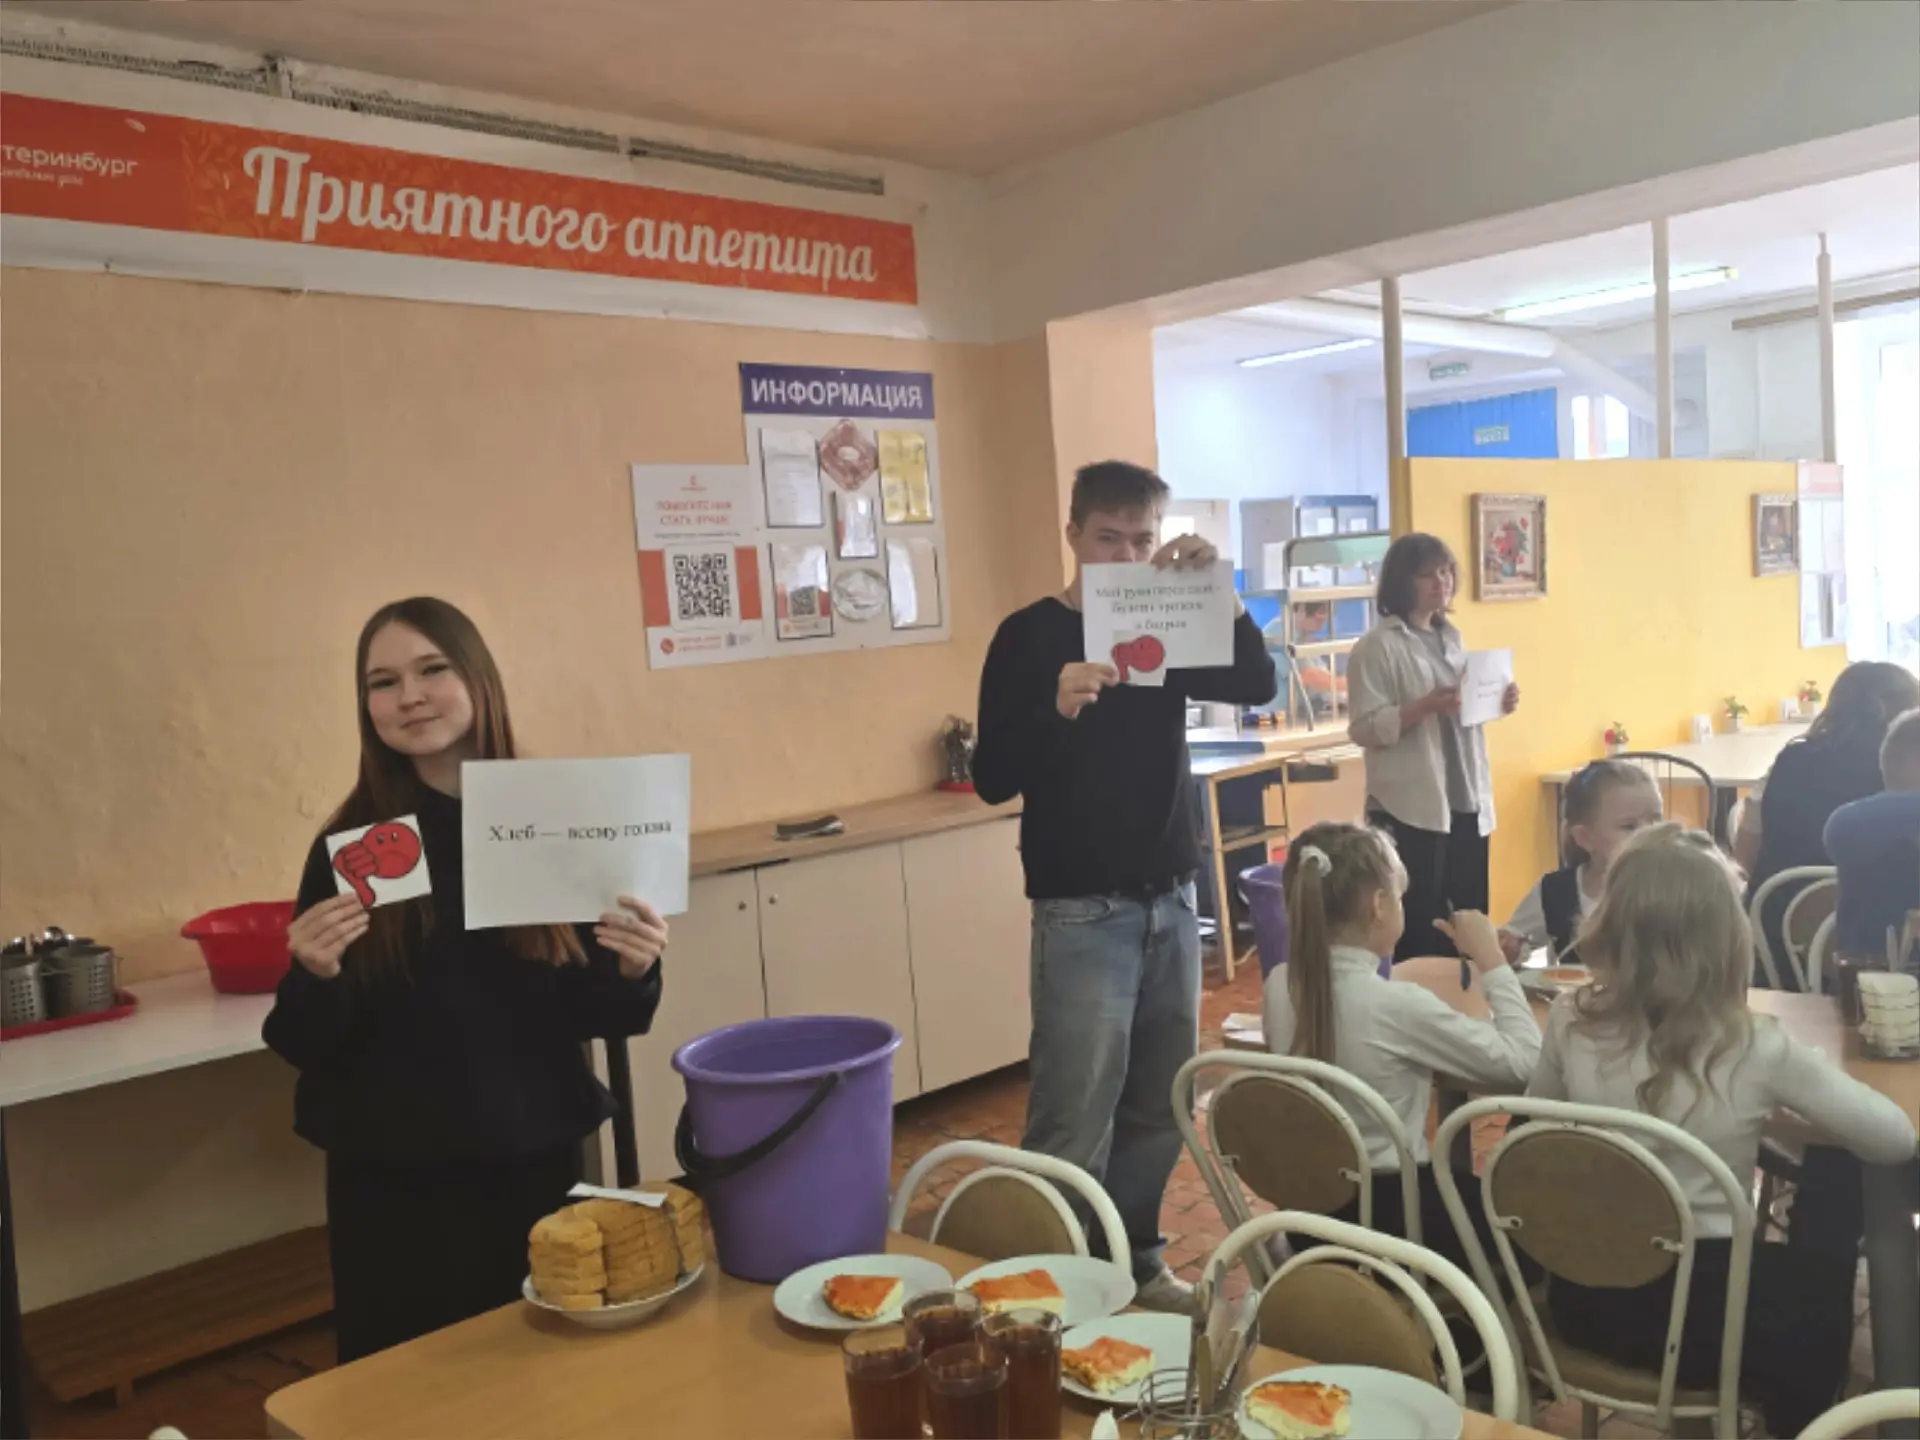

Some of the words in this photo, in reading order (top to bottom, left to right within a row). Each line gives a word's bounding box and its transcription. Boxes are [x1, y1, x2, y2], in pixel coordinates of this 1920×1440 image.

[242, 145, 617, 253] Приятного
[625, 215, 878, 290] аппетита
[750, 377, 923, 412] ИНФОРМАЦИЯ
[488, 823, 536, 842] Хлеб
[567, 825, 618, 842] всему
[623, 819, 672, 837] голова
